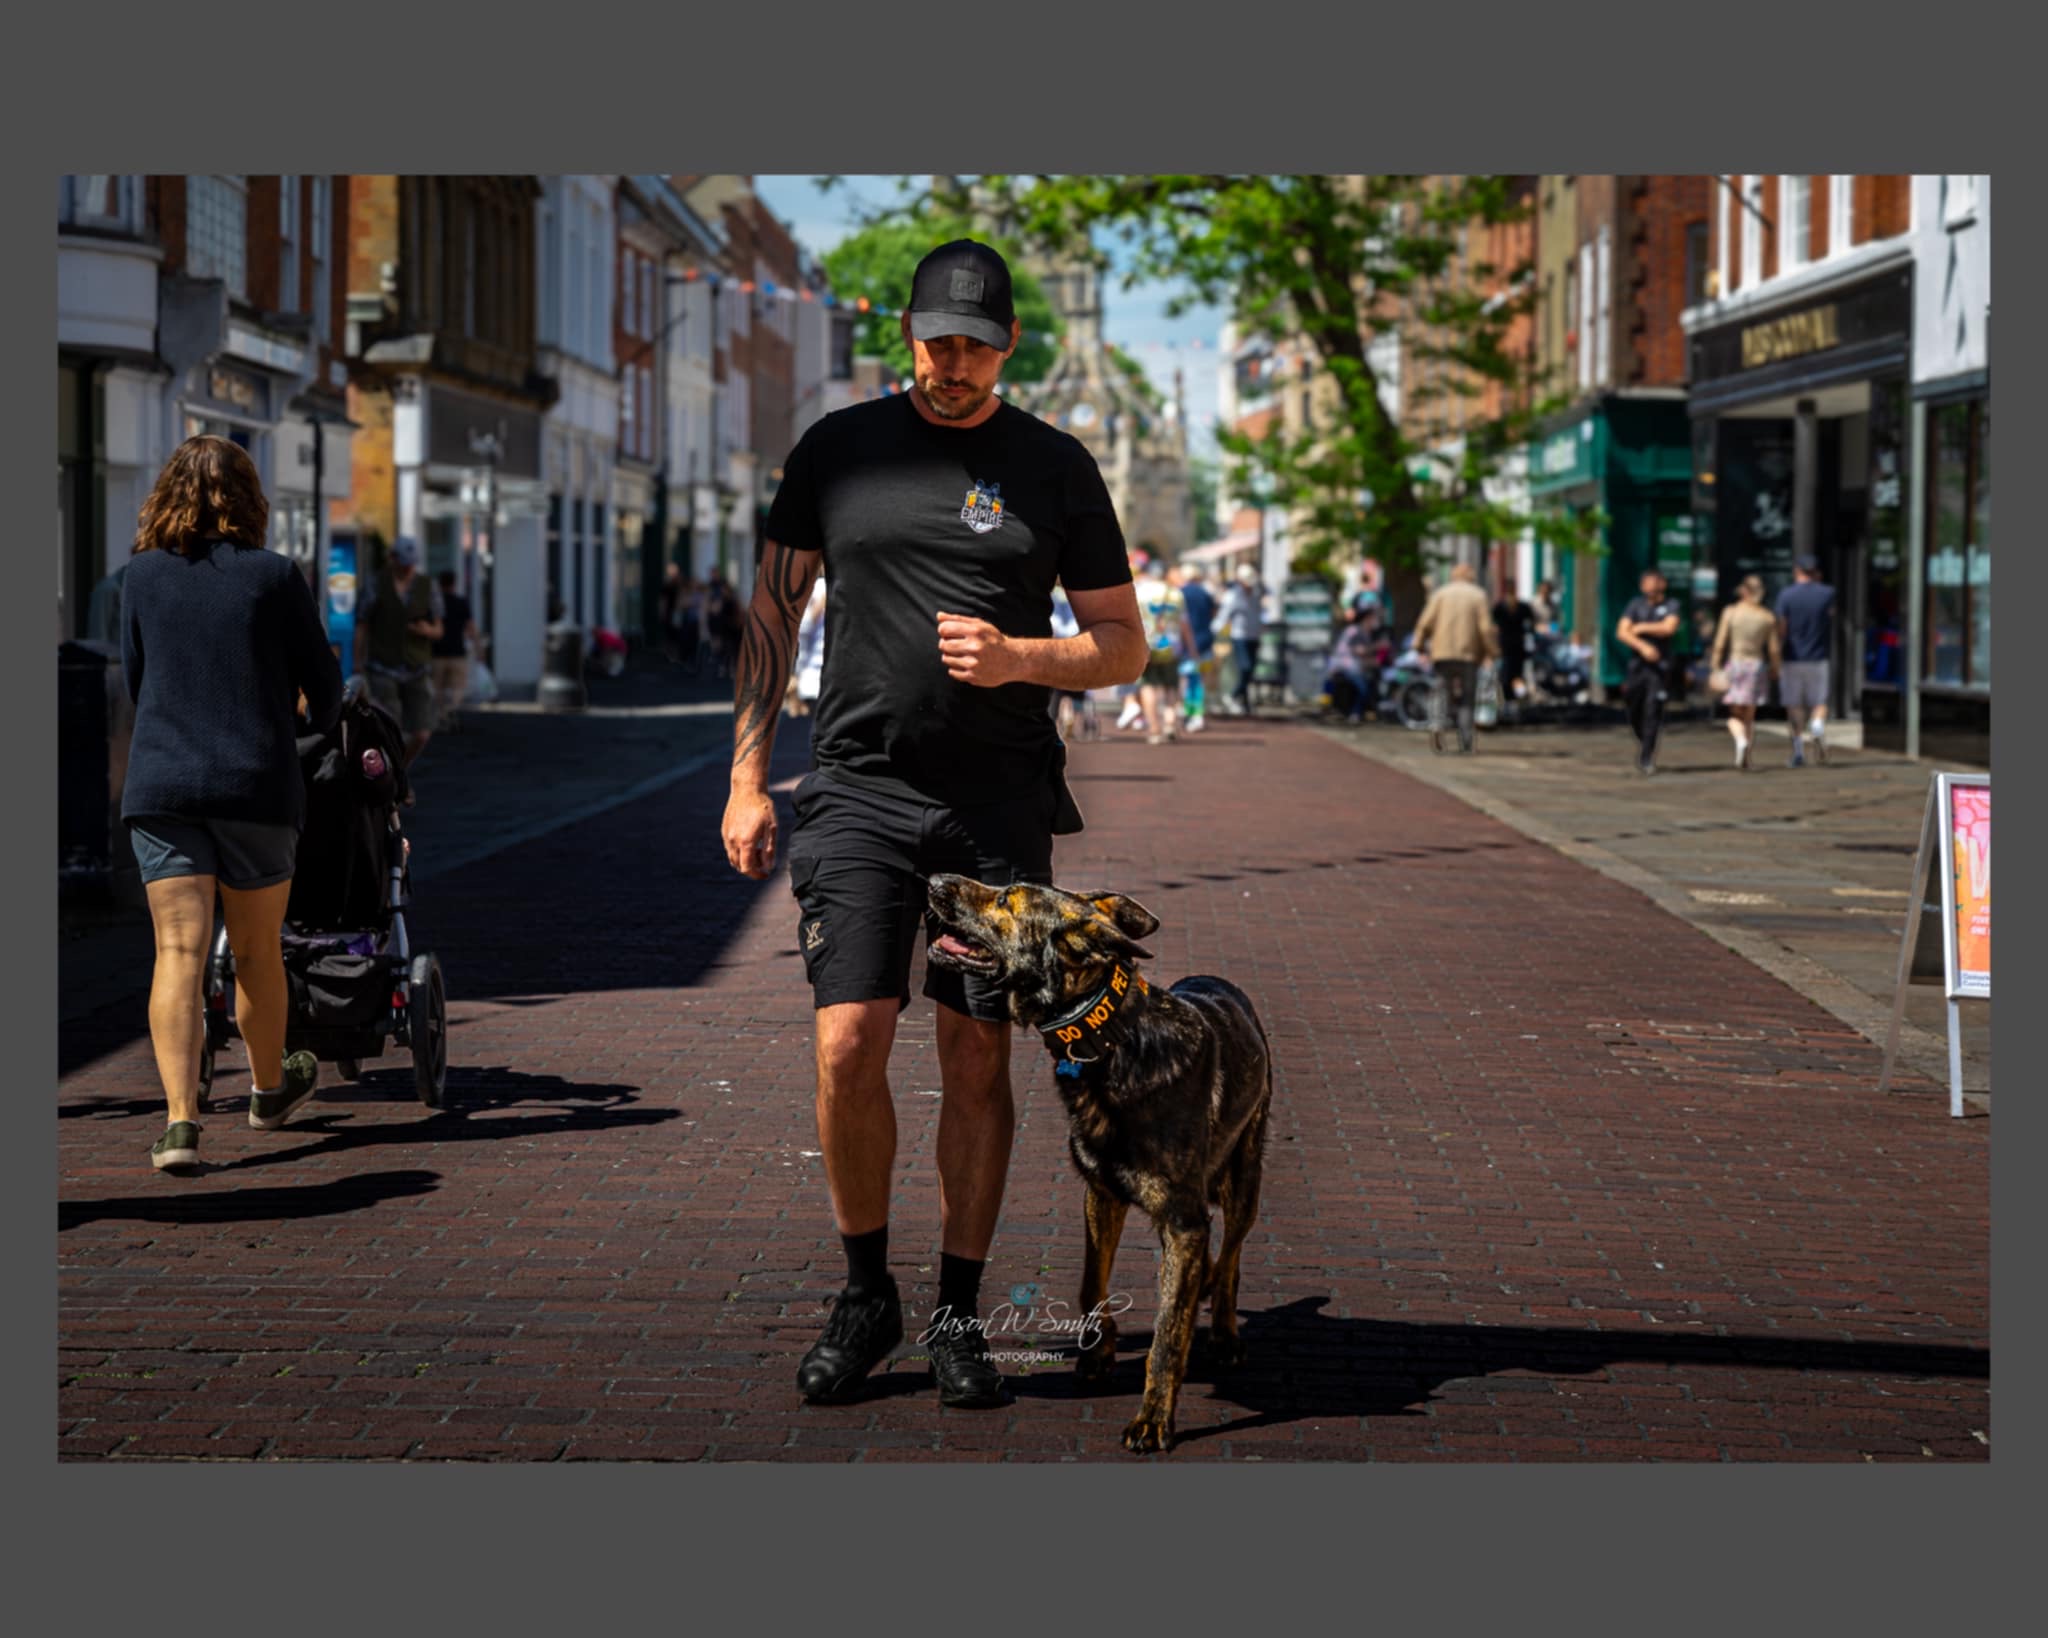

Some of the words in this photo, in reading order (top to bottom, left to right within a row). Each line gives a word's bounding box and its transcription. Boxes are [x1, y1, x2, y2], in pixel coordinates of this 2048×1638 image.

[960, 506, 1003, 527] EMPIRE
[1056, 1025, 1082, 1043] DO
[1084, 996, 1115, 1029] NOT
[1111, 965, 1129, 996] PET
